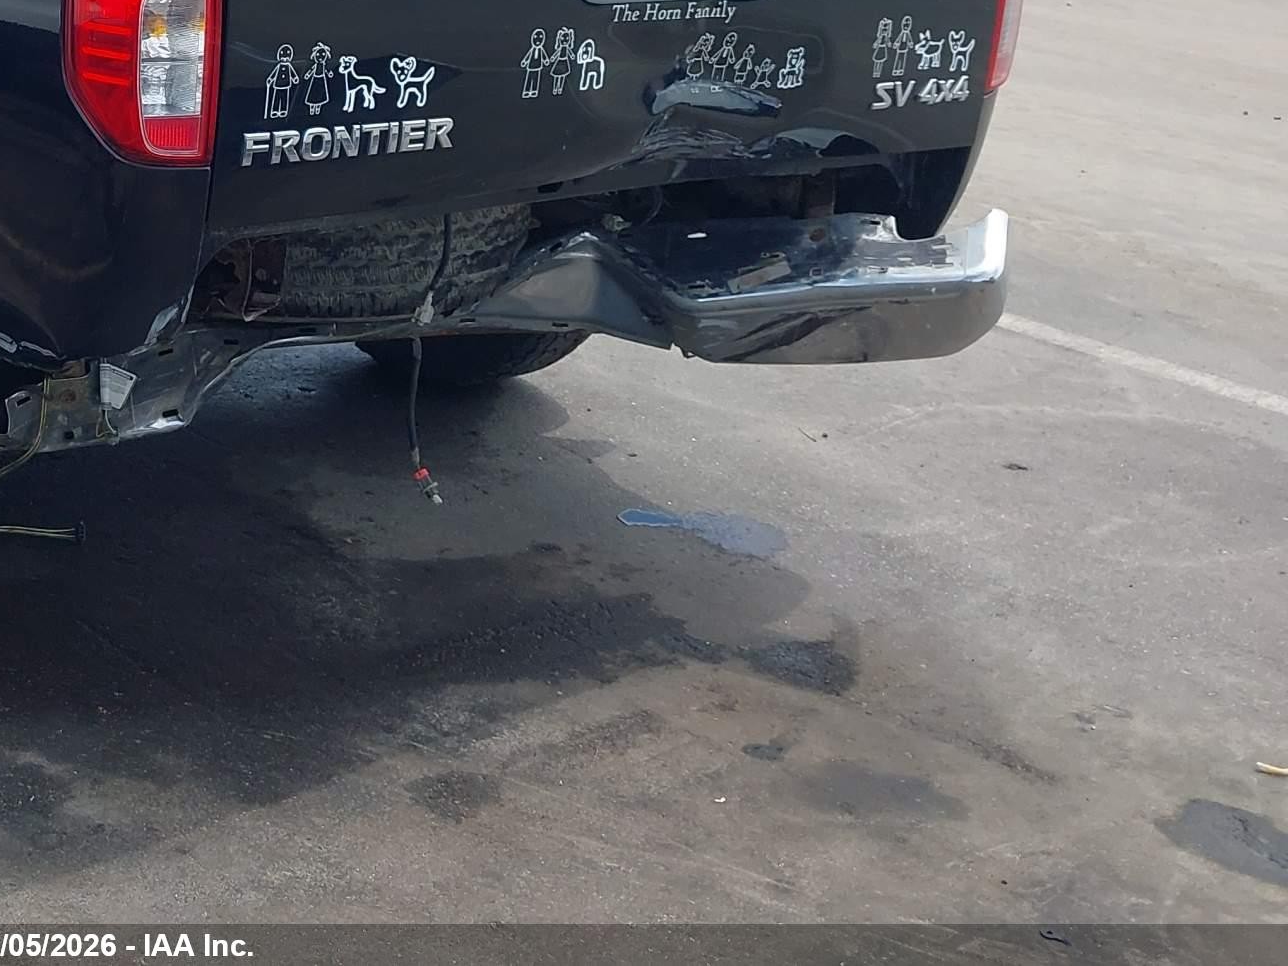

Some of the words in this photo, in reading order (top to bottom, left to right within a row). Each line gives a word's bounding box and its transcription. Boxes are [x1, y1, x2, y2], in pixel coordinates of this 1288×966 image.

[612, 4, 640, 22] The
[643, 3, 681, 21] Horn
[685, 0, 737, 24] Family
[871, 80, 916, 110] SV
[241, 117, 454, 167] FRONTIER
